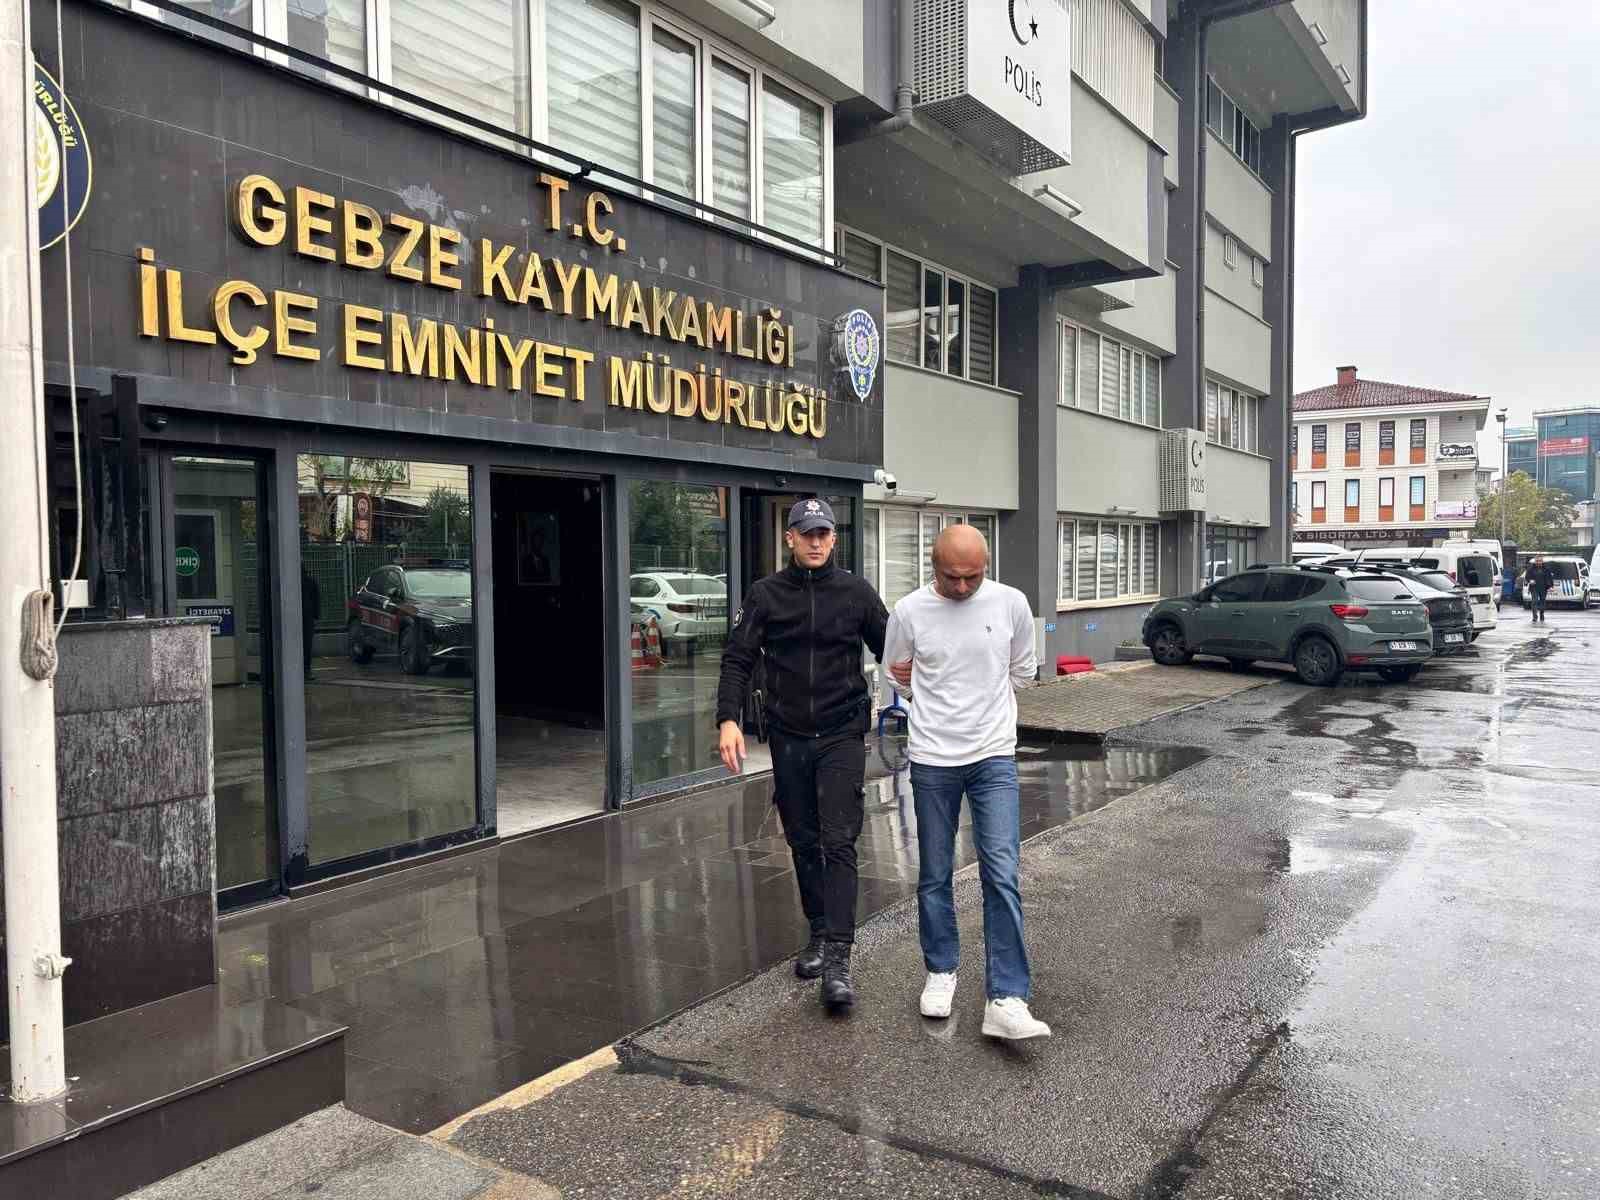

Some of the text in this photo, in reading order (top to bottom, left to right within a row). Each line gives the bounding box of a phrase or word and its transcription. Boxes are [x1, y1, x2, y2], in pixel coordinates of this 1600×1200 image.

[33, 80, 78, 147] ÜRLÜĞÜ
[1004, 55, 1042, 107] POLİS
[535, 173, 626, 252] T.C.
[235, 174, 795, 368] GEBZE KAYMAKAMLIĞI
[136, 247, 827, 439] İLÇE EMNİYET MÜDÜRLÜĞÜ
